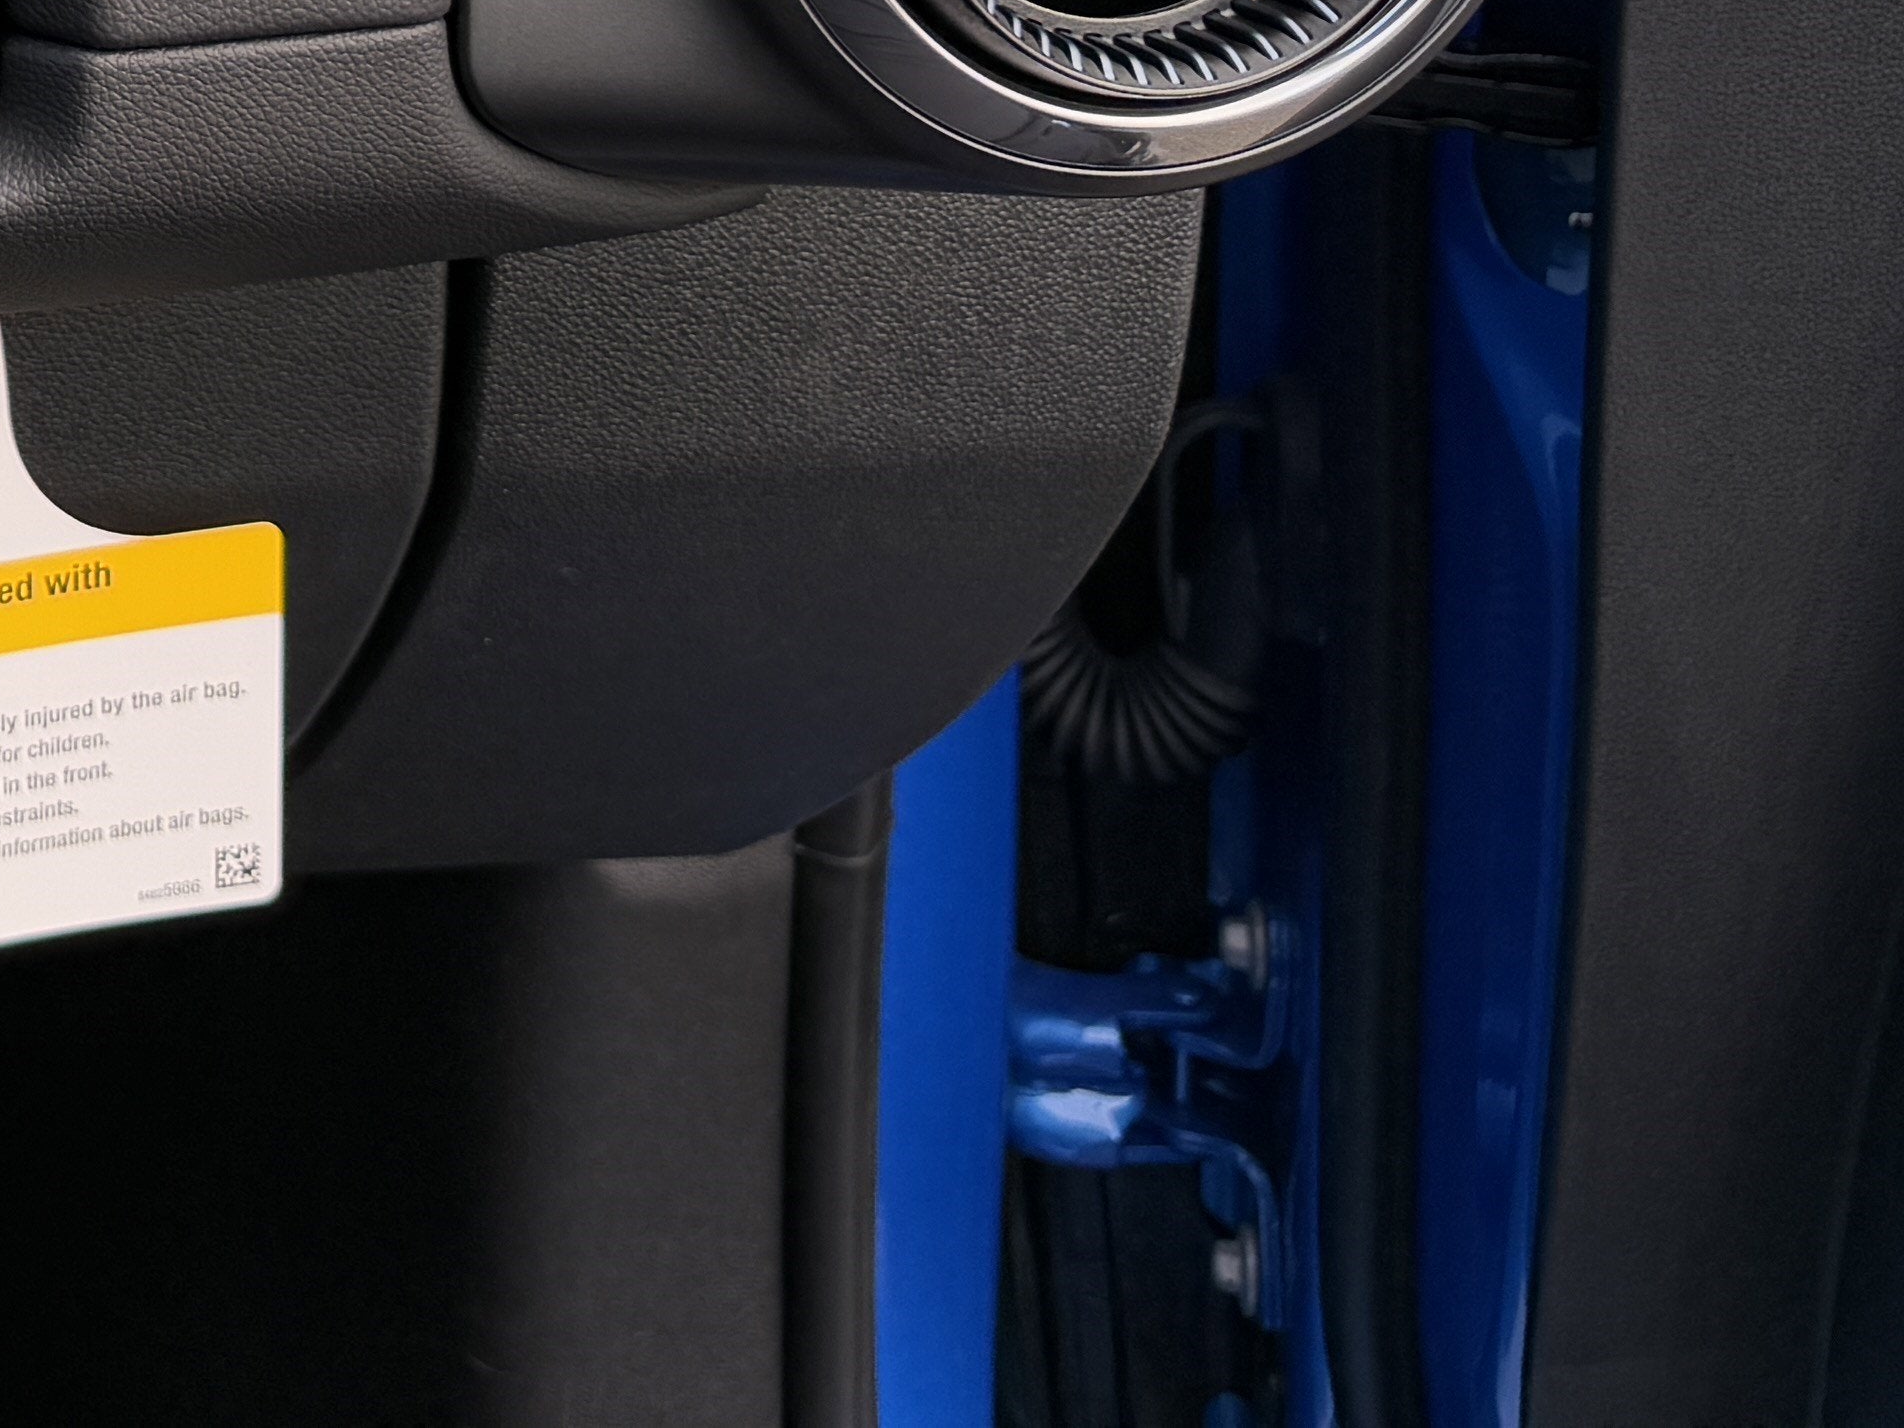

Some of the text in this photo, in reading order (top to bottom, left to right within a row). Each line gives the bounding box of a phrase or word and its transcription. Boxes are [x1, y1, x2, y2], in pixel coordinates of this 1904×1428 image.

[45, 561, 111, 596] with
[24, 698, 94, 729] injured
[100, 696, 125, 717] by
[131, 690, 163, 710] the
[170, 683, 199, 704] air
[3, 776, 20, 796] in
[26, 771, 57, 791] the
[109, 814, 164, 840] about
[167, 810, 194, 832] air
